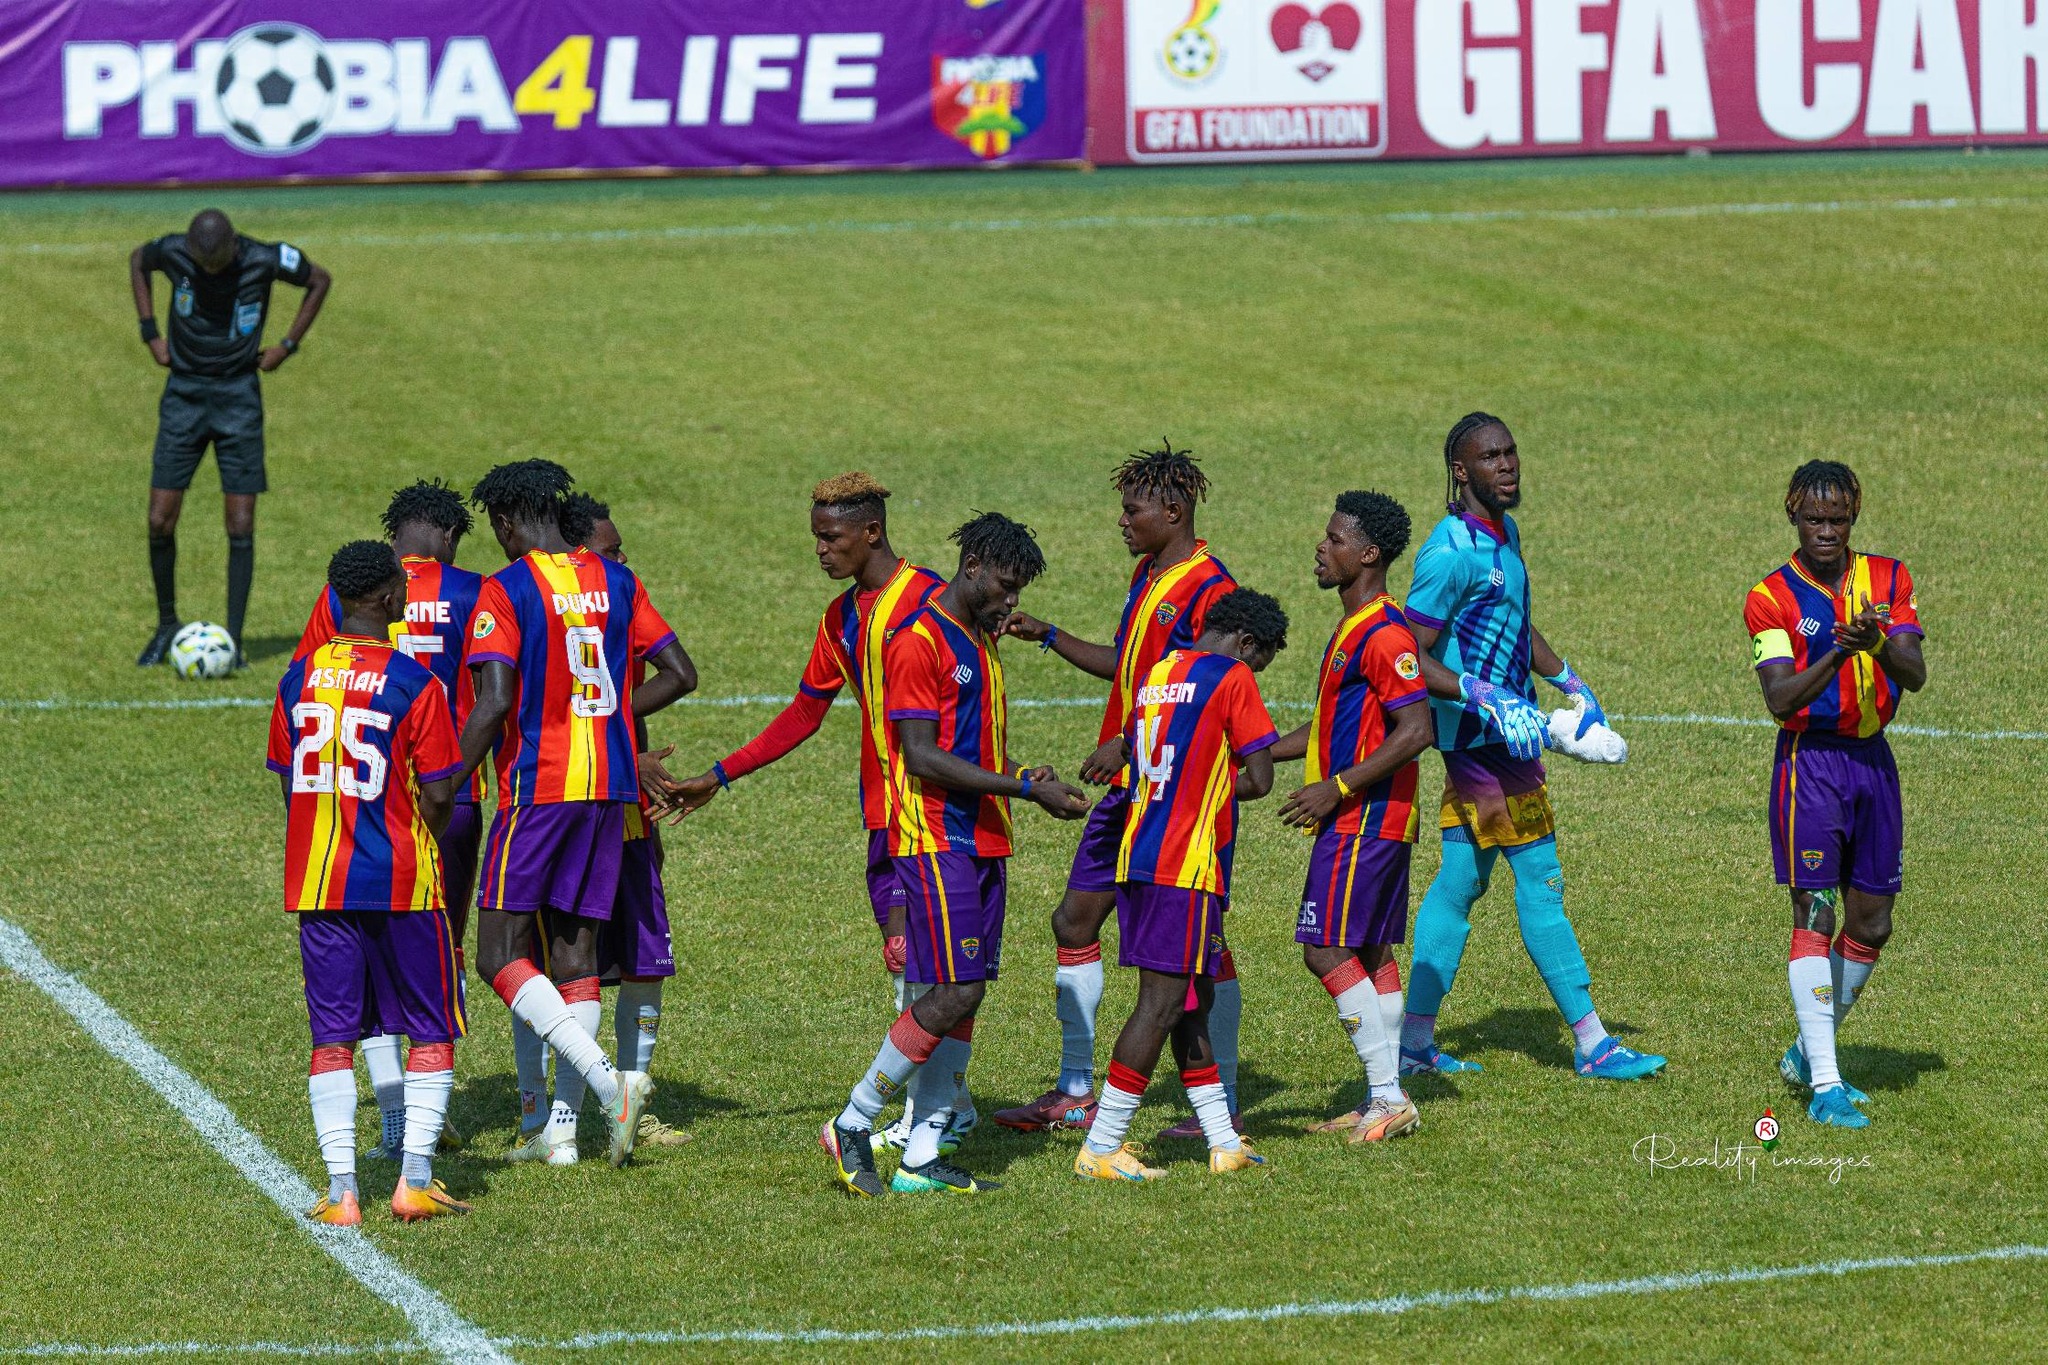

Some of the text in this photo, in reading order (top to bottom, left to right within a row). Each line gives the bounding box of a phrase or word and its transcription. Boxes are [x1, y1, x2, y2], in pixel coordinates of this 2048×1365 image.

[1413, 0, 1719, 150] GFA
[1144, 106, 1371, 150] GFA FOUNDATION
[404, 601, 451, 623] ANE
[552, 591, 610, 616] DUKU
[307, 667, 388, 696] ASMAH
[565, 625, 618, 718] 9
[291, 702, 392, 801] 25
